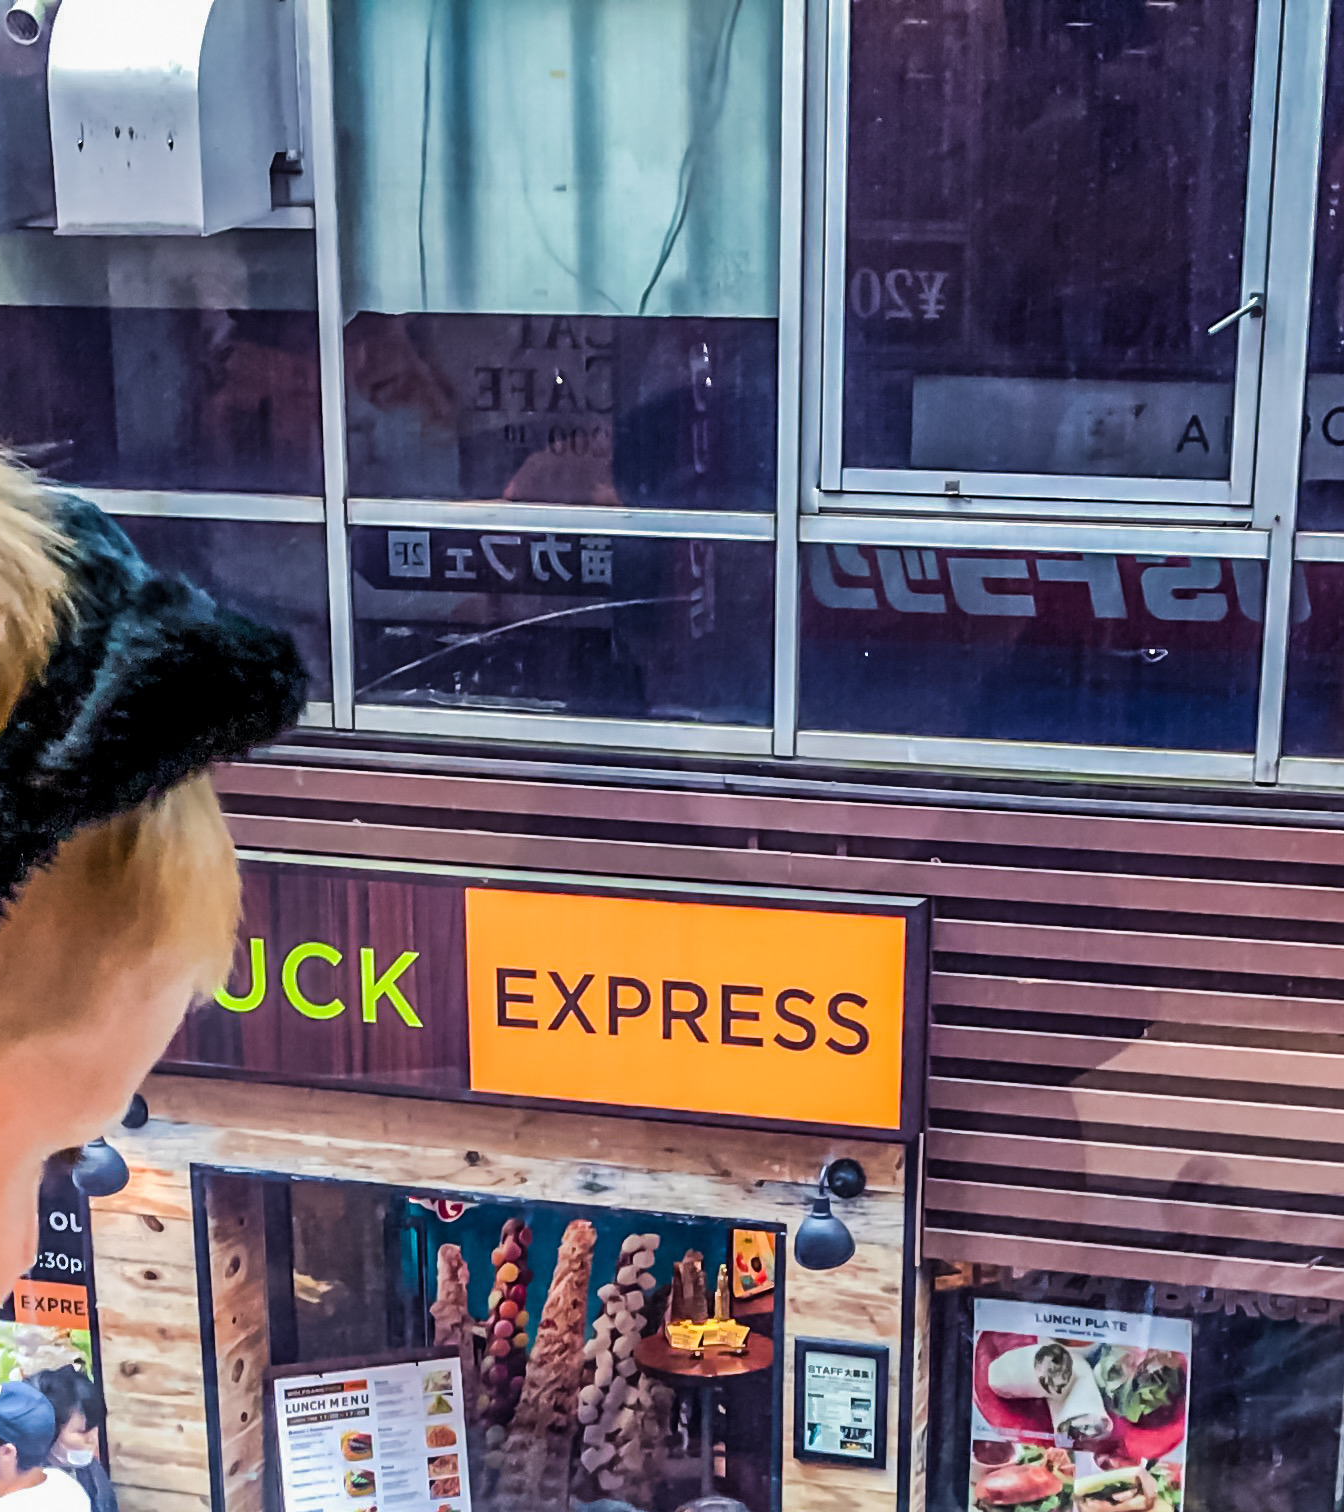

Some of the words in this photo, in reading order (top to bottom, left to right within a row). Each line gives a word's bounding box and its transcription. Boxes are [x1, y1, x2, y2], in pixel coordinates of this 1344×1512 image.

[496, 966, 870, 1056] EXPRESS
[1035, 1312, 1081, 1327] LUNCH
[1085, 1317, 1128, 1332] PLATE
[286, 1397, 326, 1414] LUNCH
[330, 1393, 370, 1409] MENU
